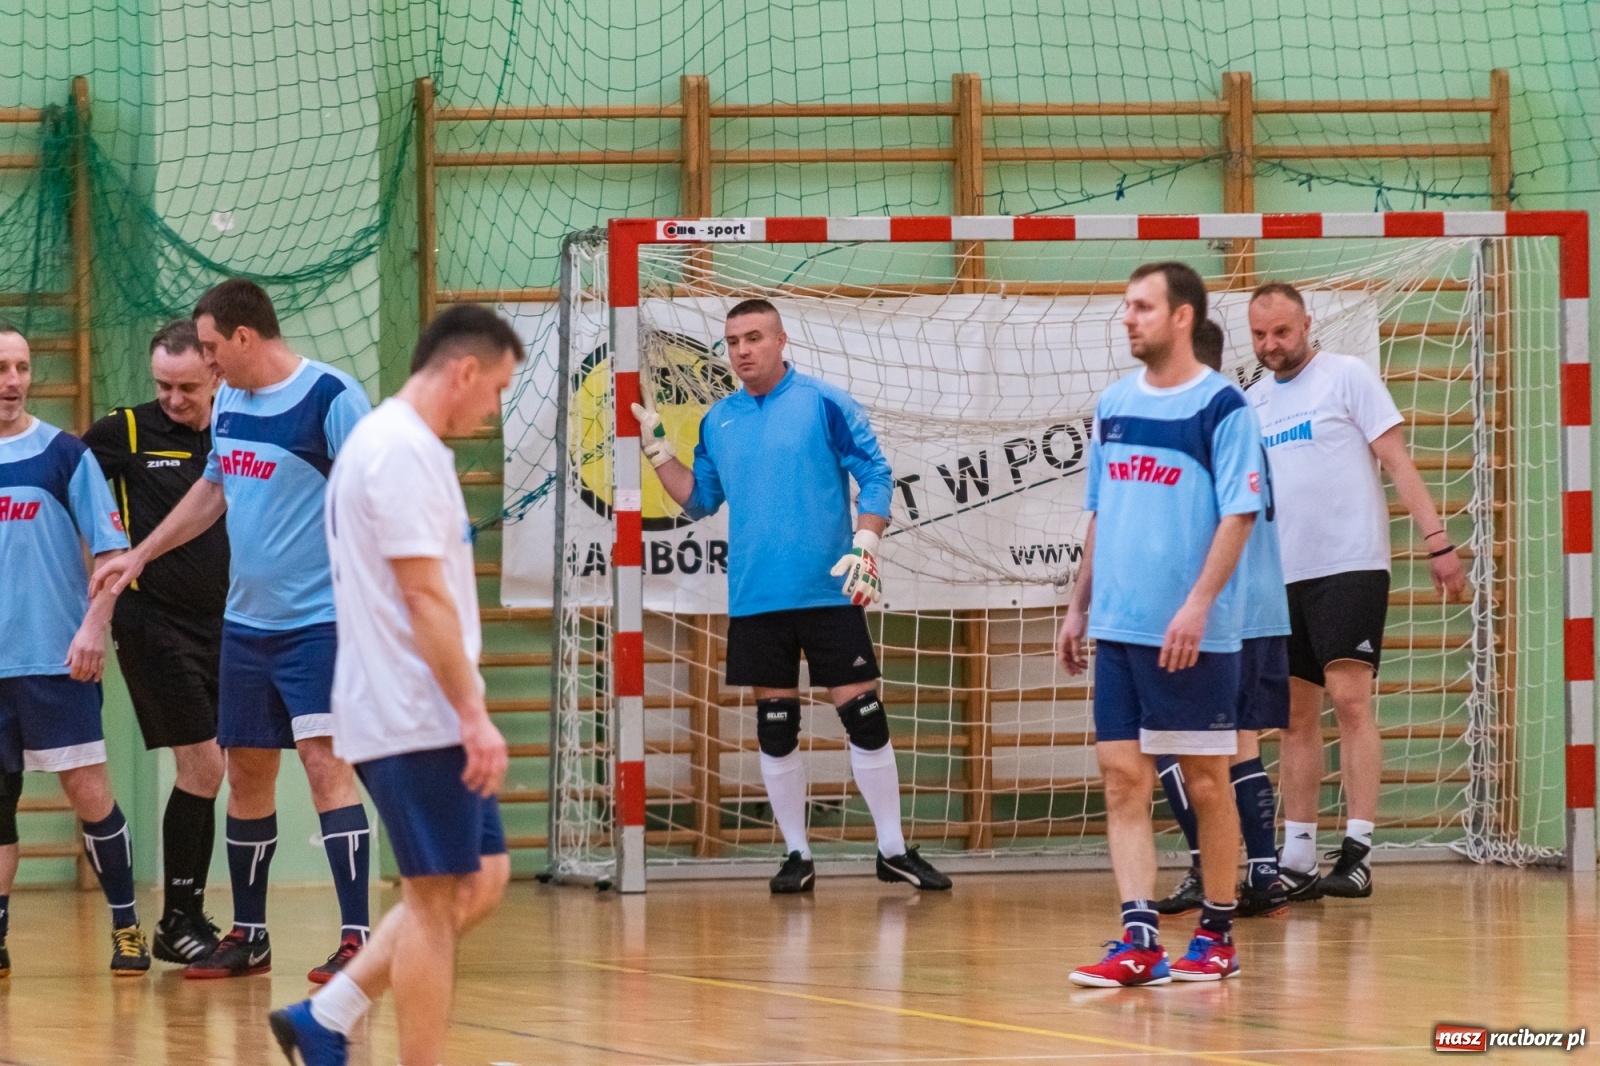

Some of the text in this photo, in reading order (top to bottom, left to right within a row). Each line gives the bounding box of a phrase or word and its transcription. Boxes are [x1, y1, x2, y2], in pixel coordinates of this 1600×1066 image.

[707, 223, 746, 238] sport
[218, 449, 277, 480] AFAKO
[888, 473, 921, 520] T
[936, 450, 990, 504] W
[766, 711, 788, 719] SELECT
[860, 701, 879, 714] SELECT
